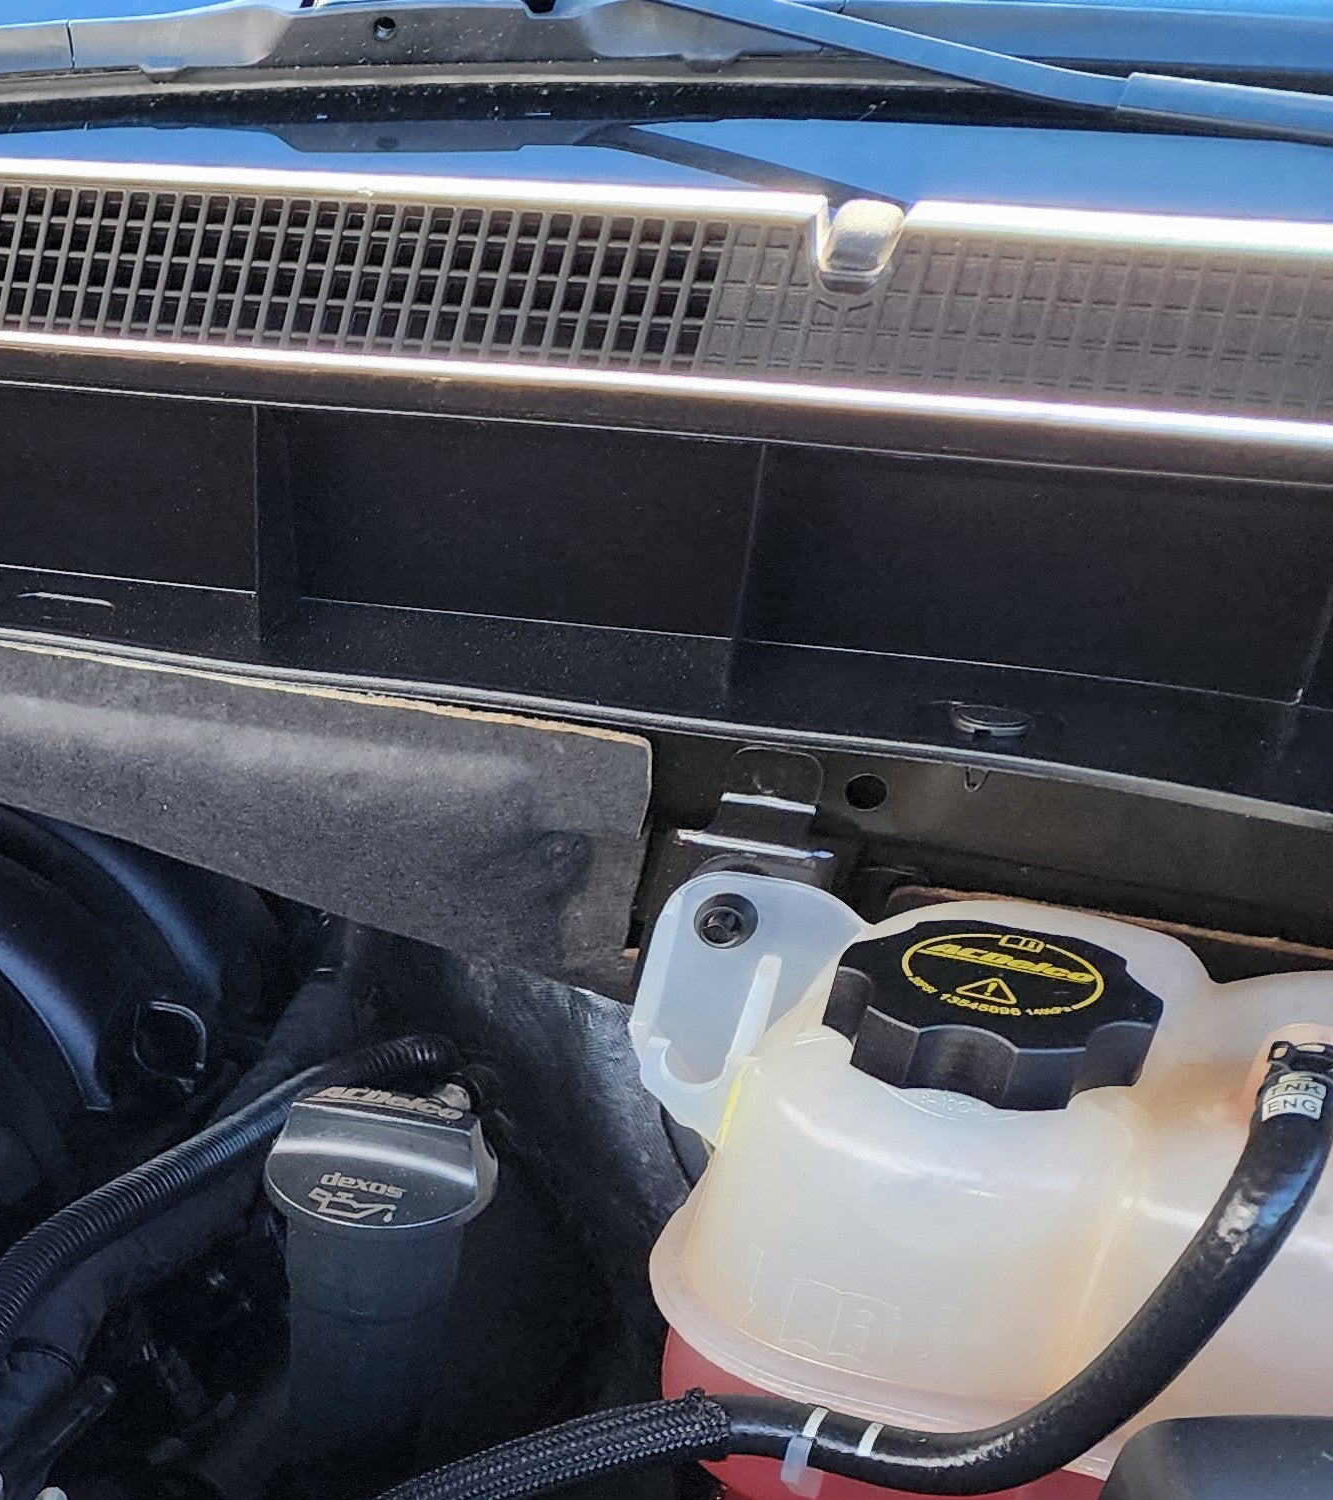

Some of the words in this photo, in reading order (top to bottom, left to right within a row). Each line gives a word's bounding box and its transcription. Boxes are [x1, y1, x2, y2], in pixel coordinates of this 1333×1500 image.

[918, 943, 1096, 985] ACDelco
[307, 1085, 464, 1121] ACDelco
[1267, 1098, 1317, 1114] ENG
[319, 1171, 408, 1199] dexos
